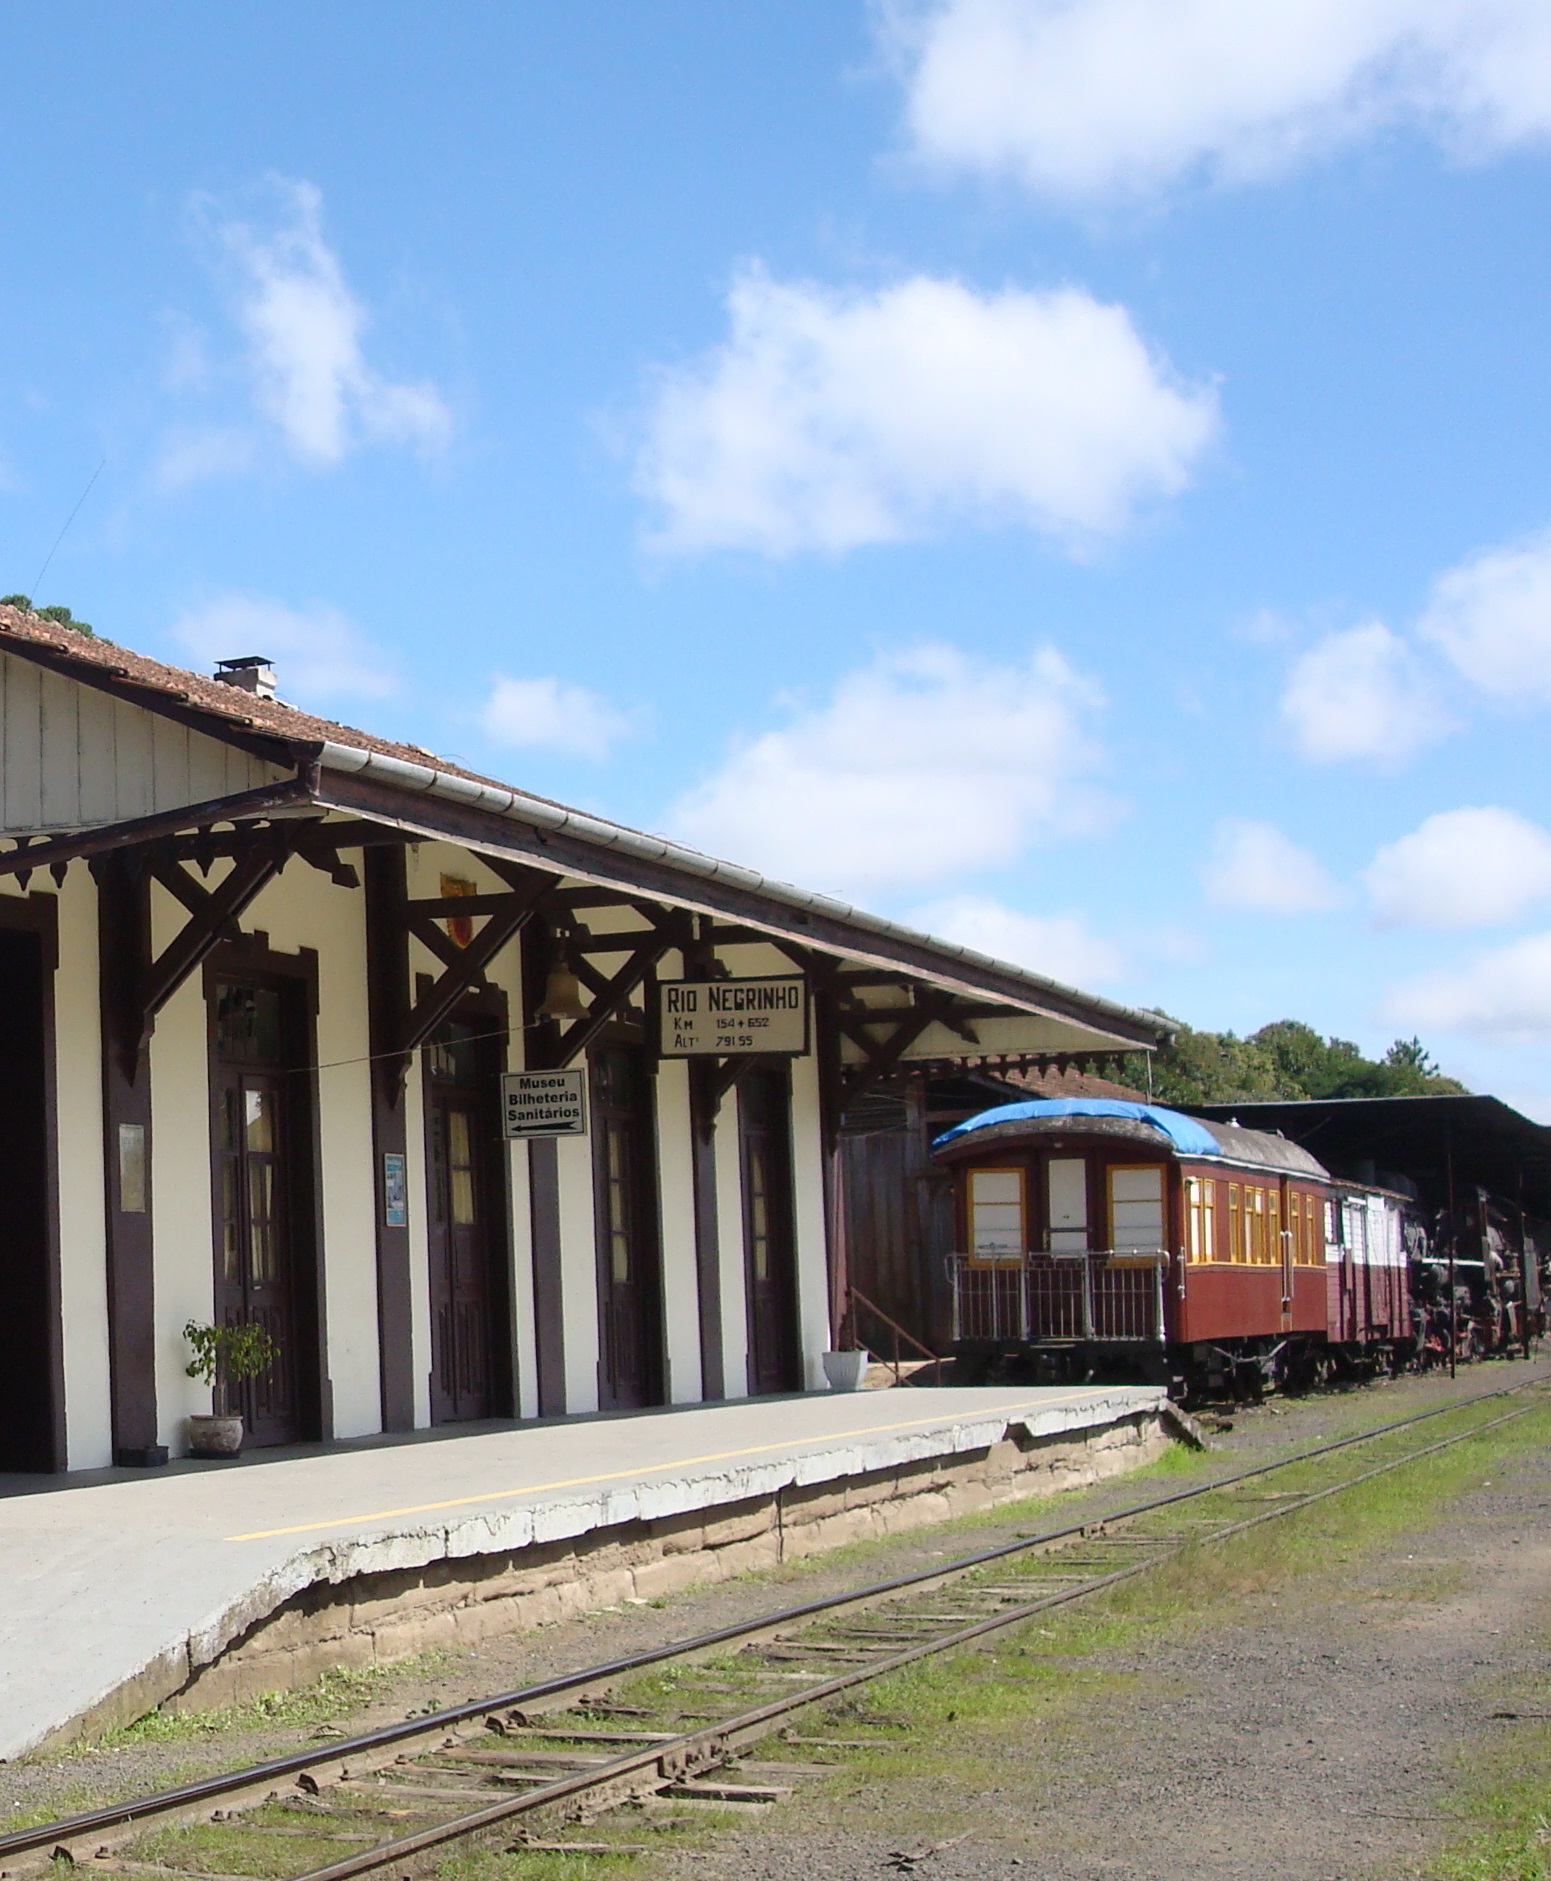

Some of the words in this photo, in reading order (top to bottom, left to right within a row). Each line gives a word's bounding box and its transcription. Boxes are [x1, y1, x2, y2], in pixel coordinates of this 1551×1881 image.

[667, 988, 697, 1013] RIO
[708, 986, 799, 1012] NEGRINHO
[519, 1078, 565, 1090] Museu
[509, 1090, 578, 1106] Bilheteria
[508, 1107, 580, 1121] Sanitários
